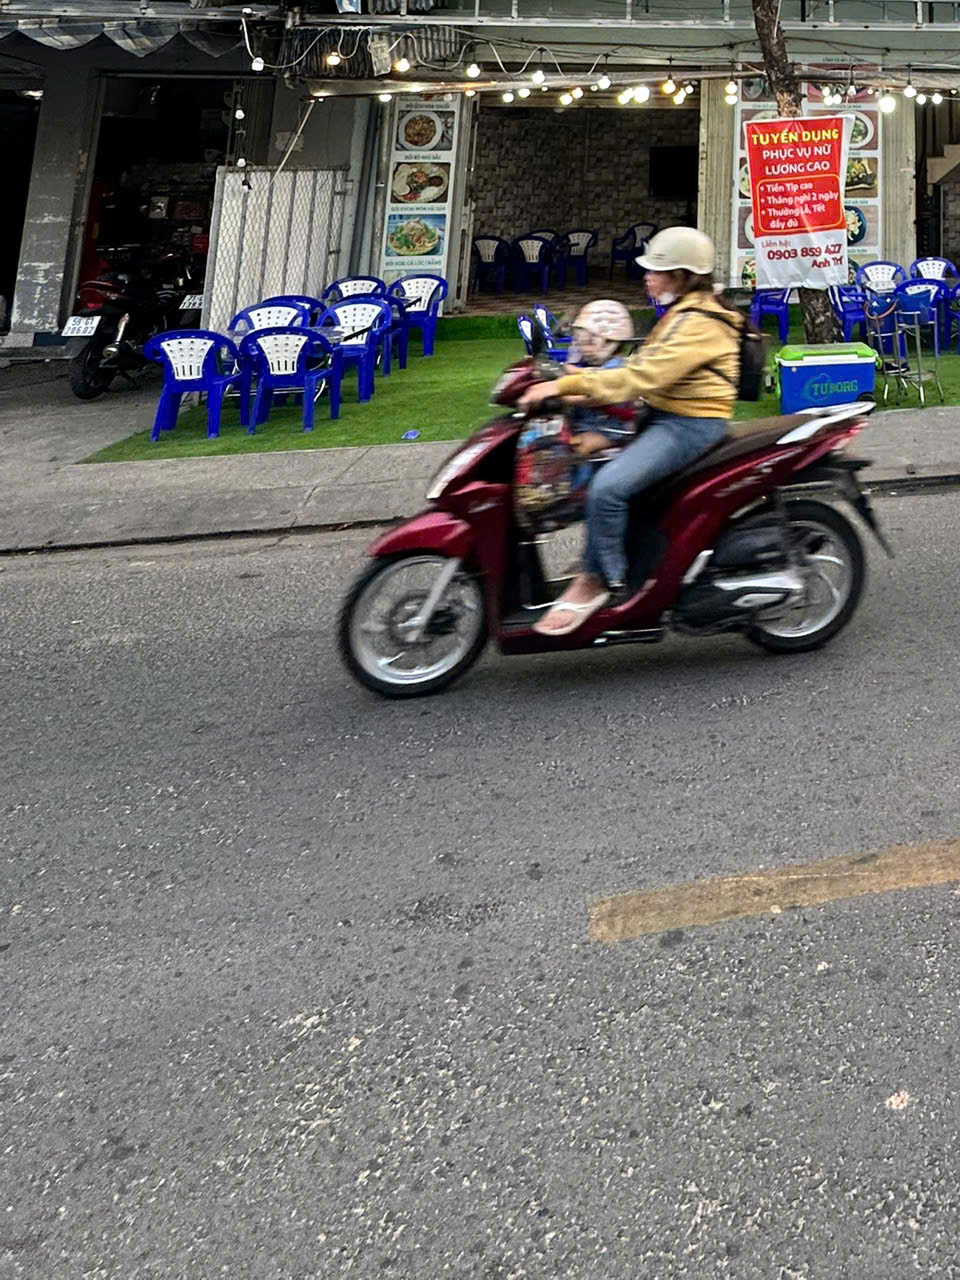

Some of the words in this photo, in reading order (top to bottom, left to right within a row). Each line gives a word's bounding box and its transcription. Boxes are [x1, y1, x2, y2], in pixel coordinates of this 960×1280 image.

[752, 128, 799, 145] TUYỂN
[802, 128, 839, 144] DỤNG
[762, 148, 795, 161] PHỤC
[797, 147, 811, 160] VỤ
[814, 143, 832, 155] NỮ
[765, 163, 805, 176] LƯƠNG
[806, 161, 830, 172] CAO
[812, 192, 817, 200] 2
[767, 249, 798, 261] 0903
[801, 247, 822, 258] 859
[825, 243, 842, 255] 427
[811, 257, 831, 269] Anh
